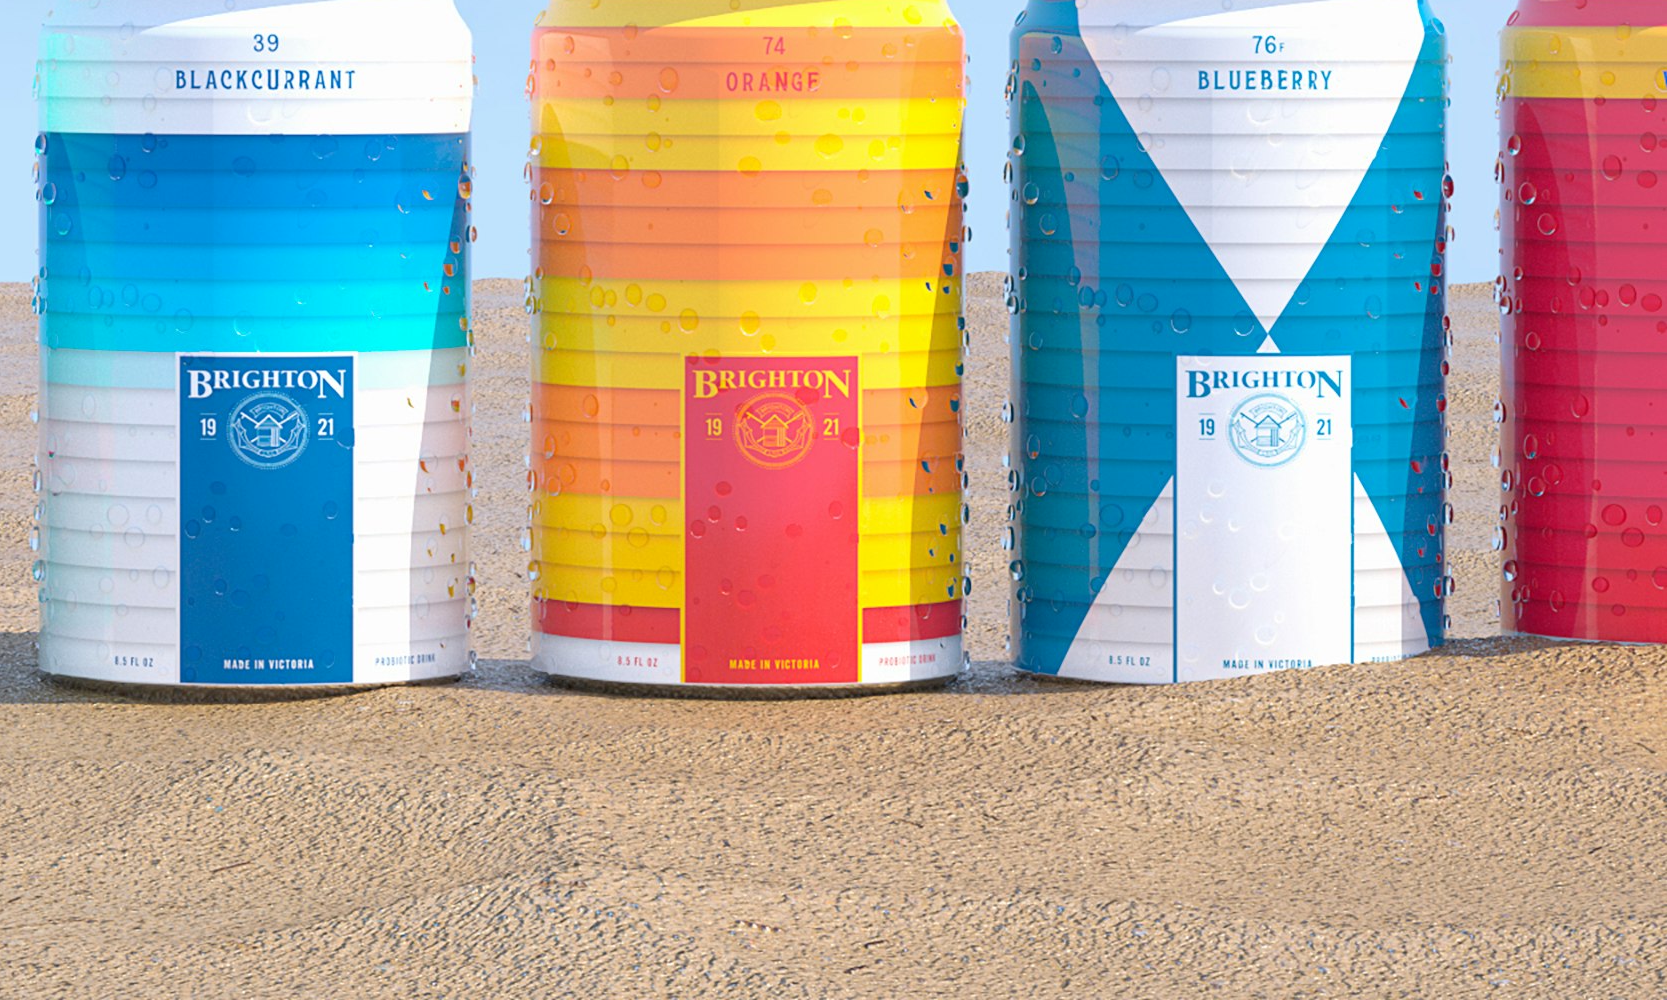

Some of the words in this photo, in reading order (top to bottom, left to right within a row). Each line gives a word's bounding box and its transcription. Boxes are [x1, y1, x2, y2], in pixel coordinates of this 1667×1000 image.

[253, 33, 279, 53] 39
[762, 36, 786, 55] 74
[175, 68, 356, 90] BLACKCURRANT
[725, 71, 820, 92] ORANGE
[1197, 69, 1333, 90] BLUEBERRY
[187, 369, 347, 399] BRIGHTON
[692, 369, 851, 399] BRIGHTON
[1185, 369, 1343, 399] BRIGHTON
[200, 418, 216, 436] 19
[317, 418, 334, 436] 21
[705, 418, 722, 436] 19
[823, 418, 839, 436] 21
[1199, 418, 1215, 436] 19
[1316, 418, 1332, 436] 21
[130, 657, 139, 666] FL
[143, 657, 154, 667] OZ
[223, 659, 251, 670] MADE
[254, 659, 265, 670] IN
[268, 659, 314, 670] VICTORIA
[375, 655, 414, 666] PROBIOTIC
[417, 653, 436, 664] DRINK
[634, 657, 643, 666] FL
[647, 657, 658, 667] OZ
[729, 659, 756, 670] MADE
[760, 659, 771, 670] IN
[774, 659, 820, 670] VICTORIA
[878, 655, 917, 666] PROBIOTIC
[919, 653, 936, 664] DRINK
[1126, 656, 1135, 665] FL
[1139, 656, 1150, 666] OZ
[1223, 659, 1249, 670] MADE
[1254, 659, 1264, 670] IN
[1268, 659, 1312, 670] VICTORIA
